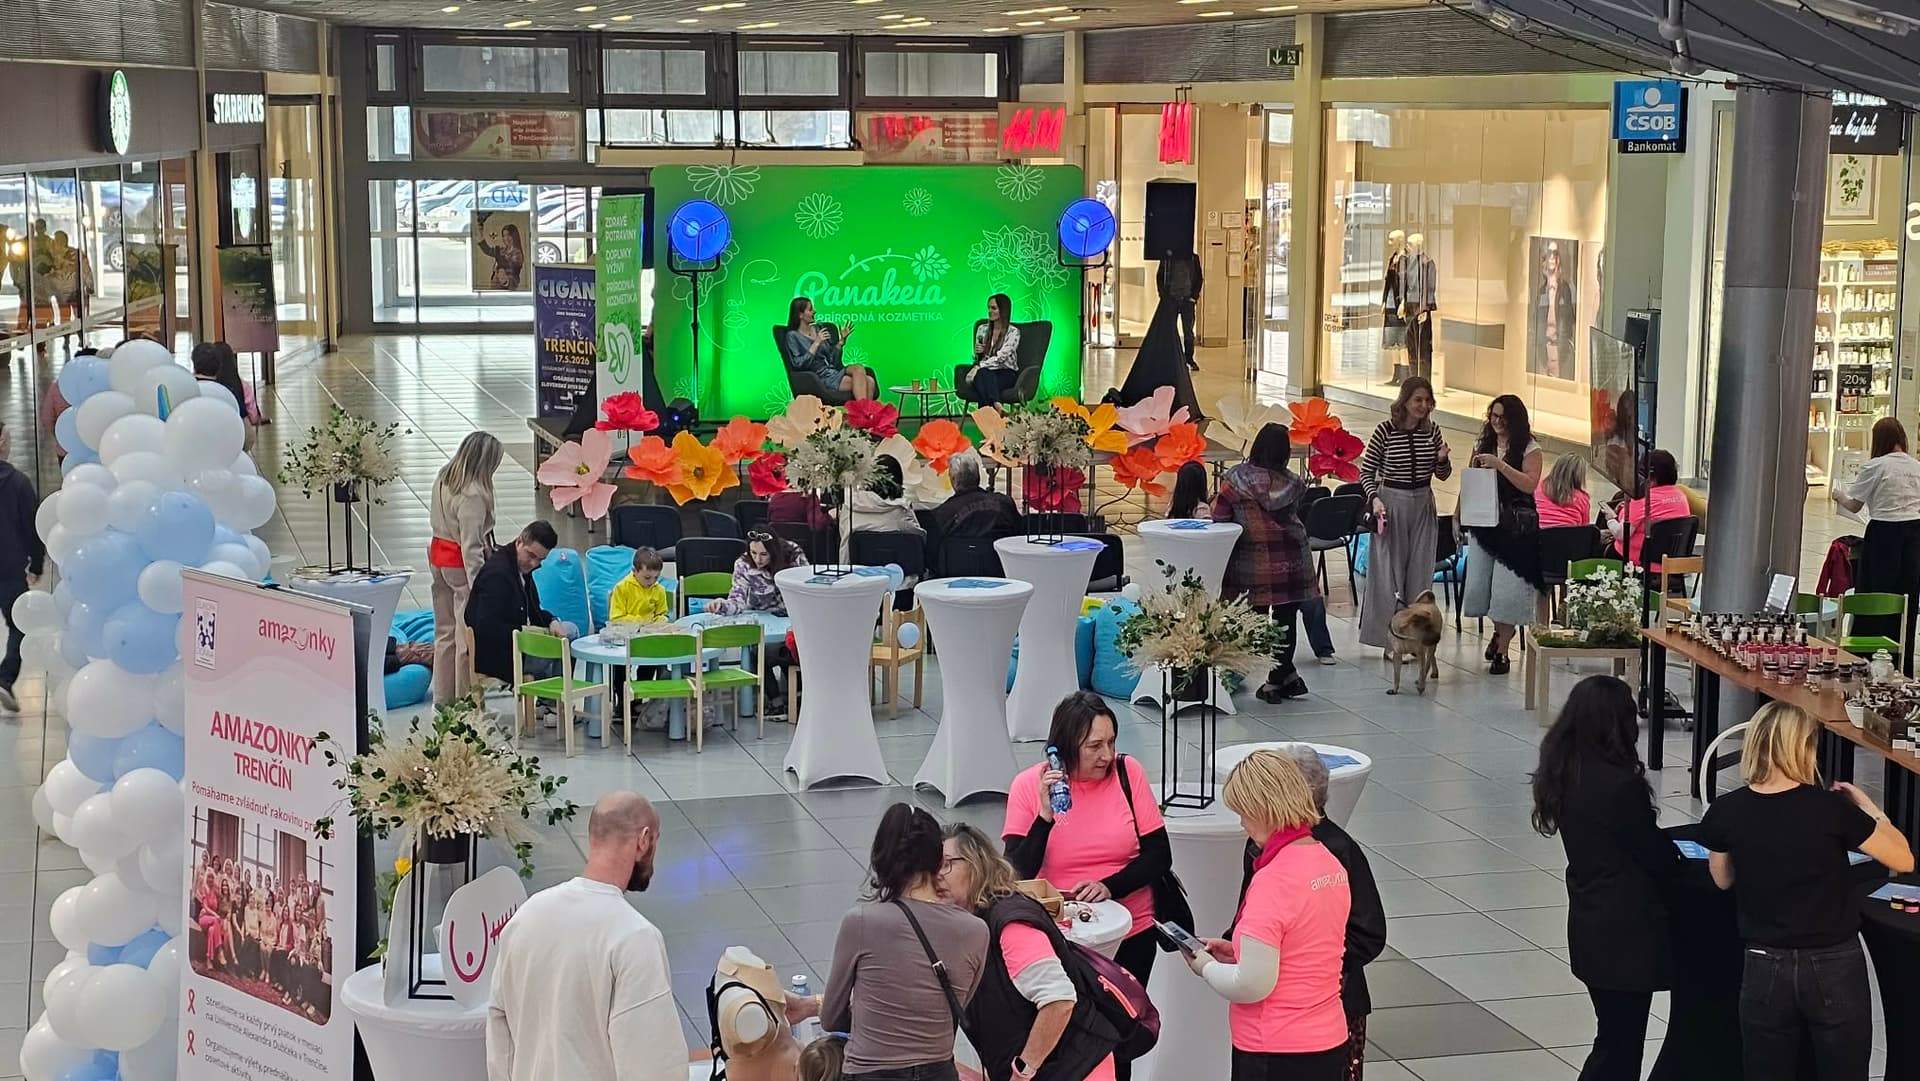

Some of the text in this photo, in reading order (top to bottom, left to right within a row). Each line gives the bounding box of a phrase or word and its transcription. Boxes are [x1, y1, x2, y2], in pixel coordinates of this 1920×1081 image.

[213, 94, 264, 124] STARBUCKS
[1625, 113, 1676, 131] ČSOB
[1627, 140, 1677, 153] Bankomat
[605, 230, 637, 242] POTRAVINY
[794, 267, 947, 307] Panakeia
[816, 311, 944, 323] PRÍRODNÁ KOZMETIKA
[543, 337, 597, 355] TRENČÍN
[555, 354, 590, 366] 17.5.2026
[1841, 374, 1867, 385] -20%
[258, 617, 336, 661] amazonky
[210, 710, 316, 766] AMAZONKY
[233, 752, 293, 792] TRENČÍN
[192, 781, 303, 827] Pomáhame zvládnuť rakovinu
